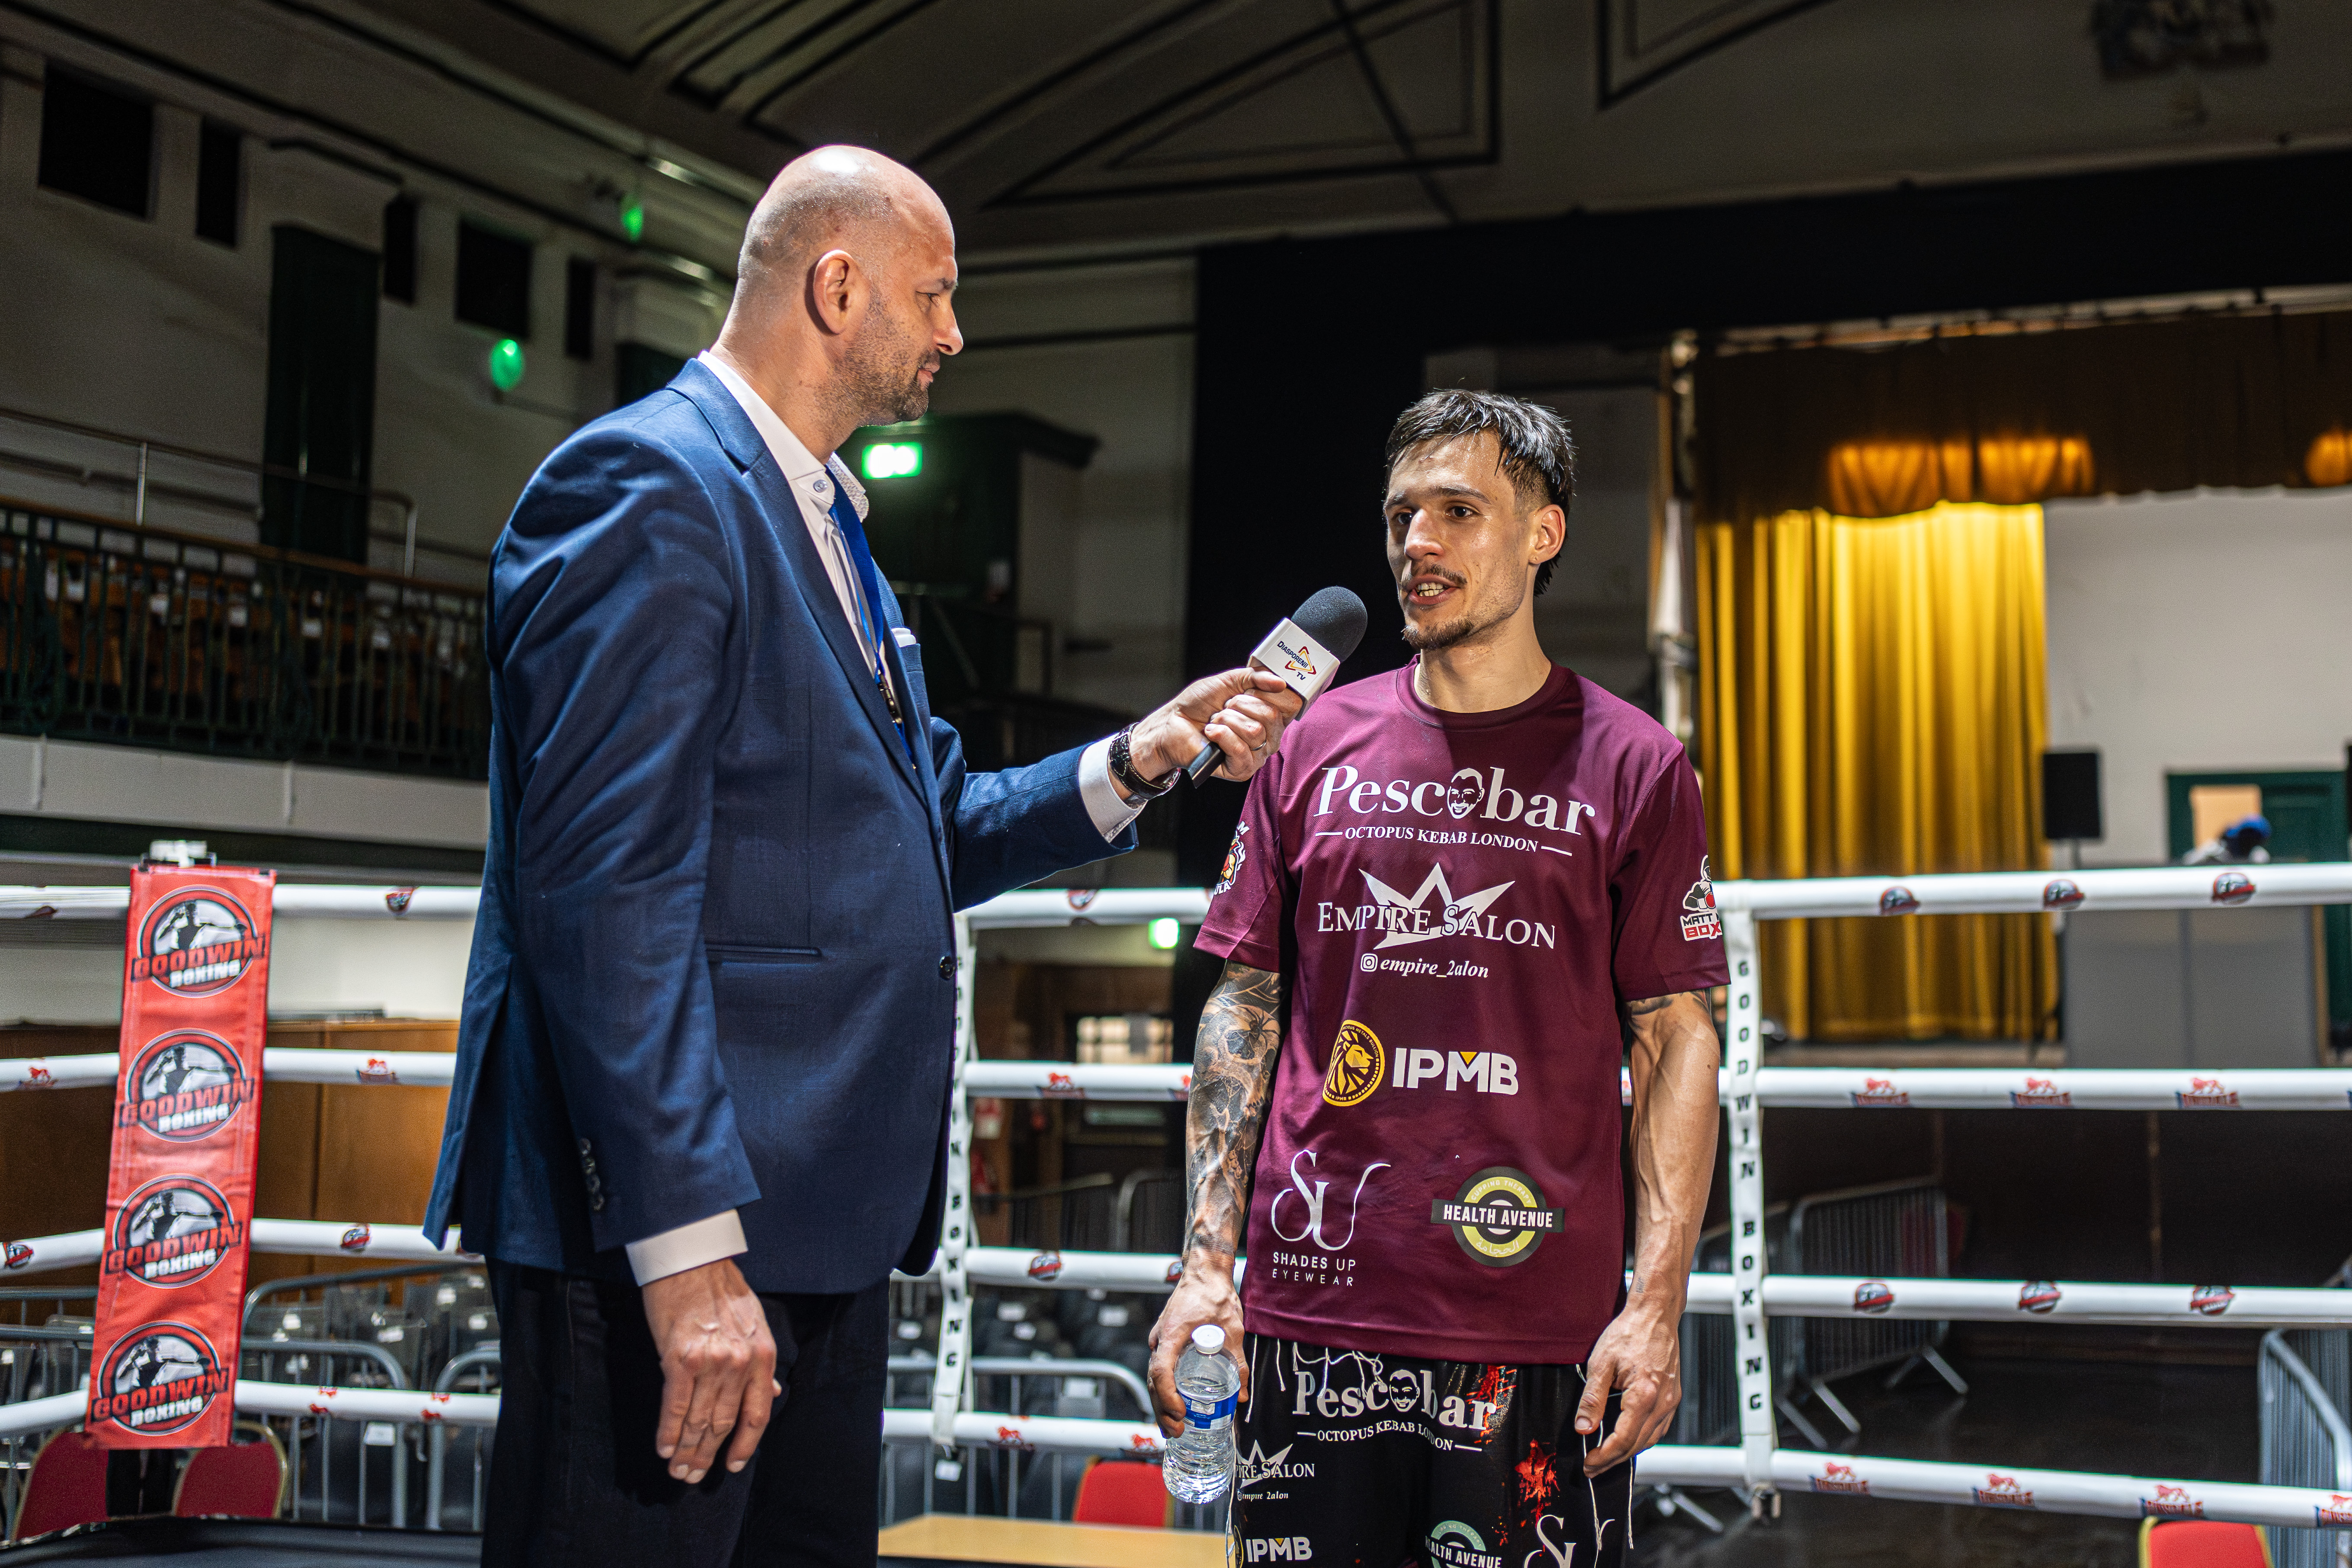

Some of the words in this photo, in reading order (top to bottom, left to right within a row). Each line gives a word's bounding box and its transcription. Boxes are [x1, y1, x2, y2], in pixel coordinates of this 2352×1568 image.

[1277, 640, 1309, 669] DIASPORENII
[1296, 672, 1306, 681] TV
[1345, 826, 1414, 840] OCTOPUS
[1417, 830, 1467, 844] KEBAB
[1470, 832, 1539, 852] LONDON
[1317, 902, 1431, 934] EMPIRE
[1442, 905, 1555, 950] SALON
[1682, 913, 1713, 927] MATT
[132, 934, 265, 981] GOODWIN
[1380, 958, 1489, 978] empire_2alon
[170, 958, 241, 988] BOXING
[1369, 1039, 1379, 1057] BULLION
[1392, 1047, 1519, 1095] IPMB
[1736, 961, 1755, 1177] GOODWIN
[120, 1078, 254, 1127] GOODWIN
[158, 1103, 229, 1133] BOXING
[1471, 1180, 1500, 1201] CUPPING
[1504, 1180, 1532, 1204] THERAPY
[1443, 1204, 1496, 1224] HEALTH
[1501, 1210, 1553, 1228] AVENUE
[106, 1222, 242, 1273] GOODWIN
[1273, 1251, 1328, 1269] SHADES
[1336, 1258, 1356, 1271] UP
[144, 1248, 217, 1279] BOXING
[1272, 1268, 1354, 1286] EYEWEAR
[1741, 1221, 1762, 1410] BOXING
[91, 1368, 229, 1421] GOODWIN
[131, 1395, 203, 1427] BOXING
[1318, 1426, 1374, 1441] OCTOPUS
[1376, 1420, 1416, 1434] KEBAB
[1418, 1424, 1453, 1451] LONDON
[1235, 1465, 1258, 1478] PIRE
[1261, 1462, 1315, 1478] SALON
[1246, 1537, 1312, 1562] IPMB
[1455, 1550, 1502, 1568] AVENUE
